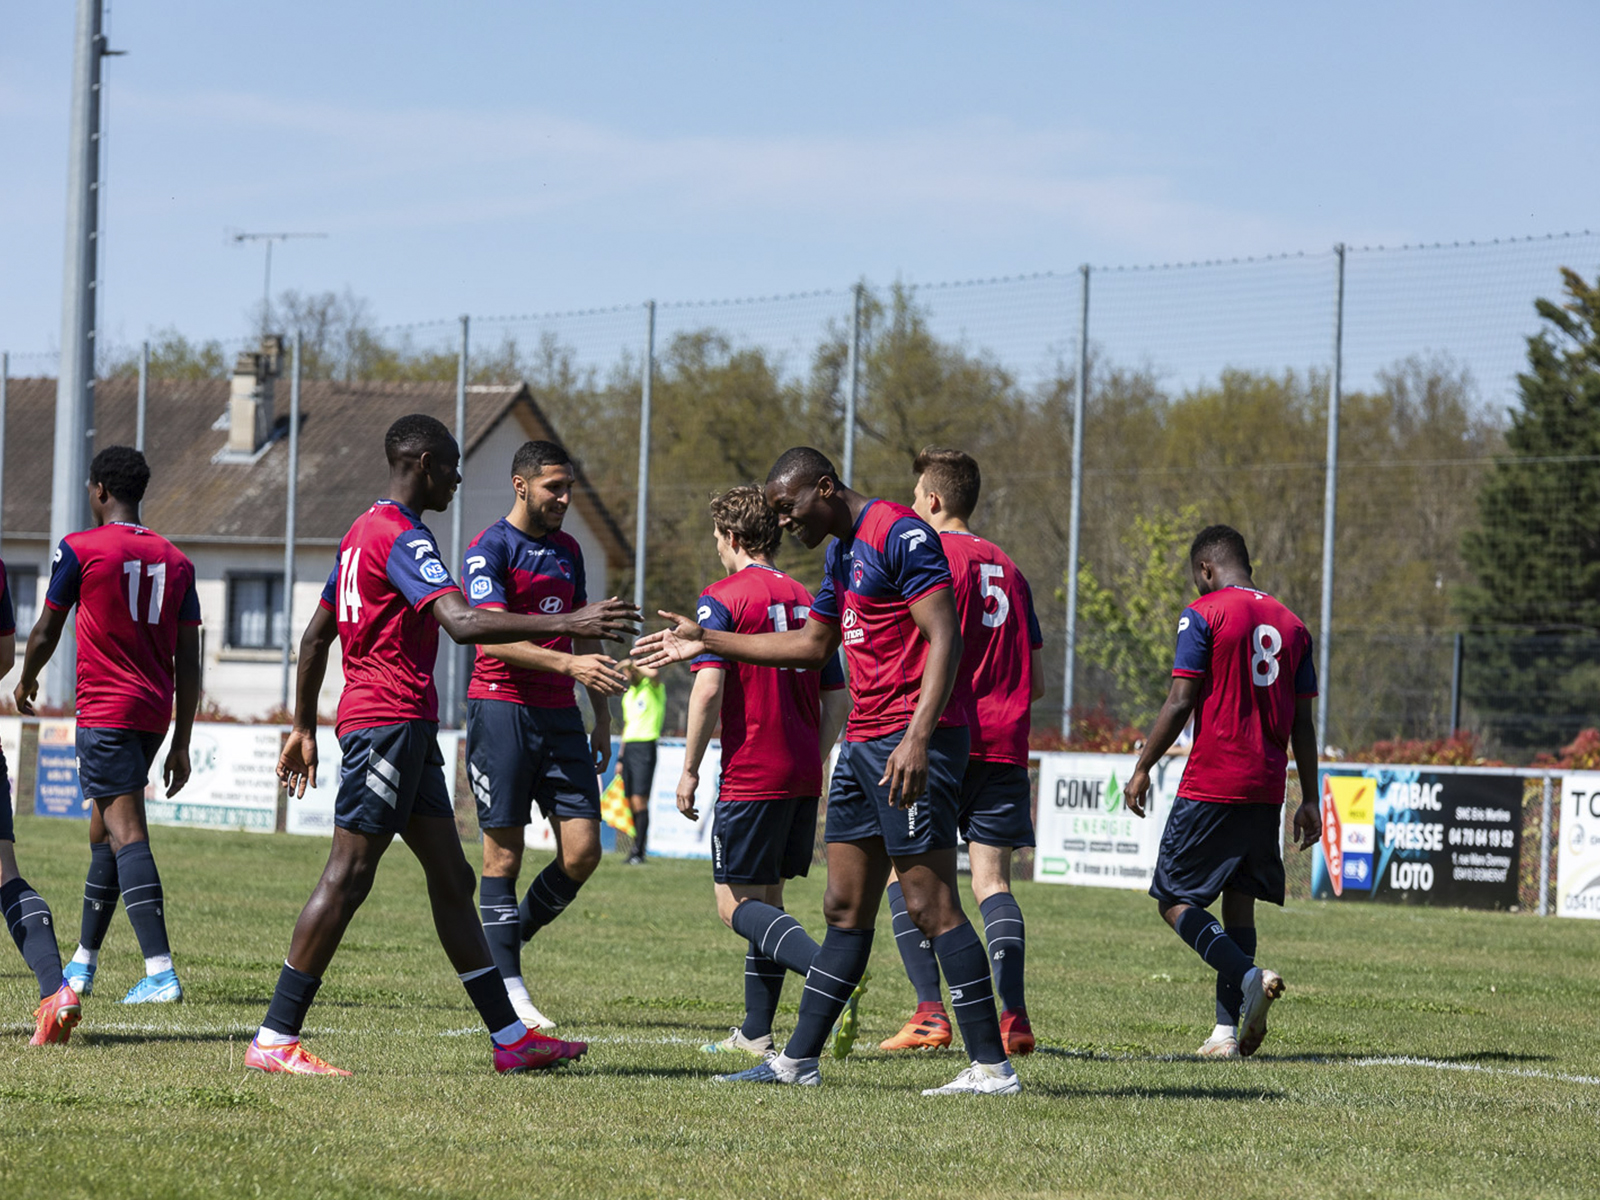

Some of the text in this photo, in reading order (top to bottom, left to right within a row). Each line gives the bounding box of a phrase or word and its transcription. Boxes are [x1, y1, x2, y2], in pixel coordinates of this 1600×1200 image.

[123, 559, 167, 625] 11
[339, 546, 363, 624] 14
[425, 563, 444, 577] N3
[473, 581, 488, 593] N3
[980, 563, 1010, 628] 5
[1251, 624, 1282, 687] 8
[1388, 782, 1444, 811] TABAC
[1324, 793, 1341, 876] TABAC
[1384, 822, 1444, 851] PRESSE
[1390, 861, 1434, 891] LOTO
